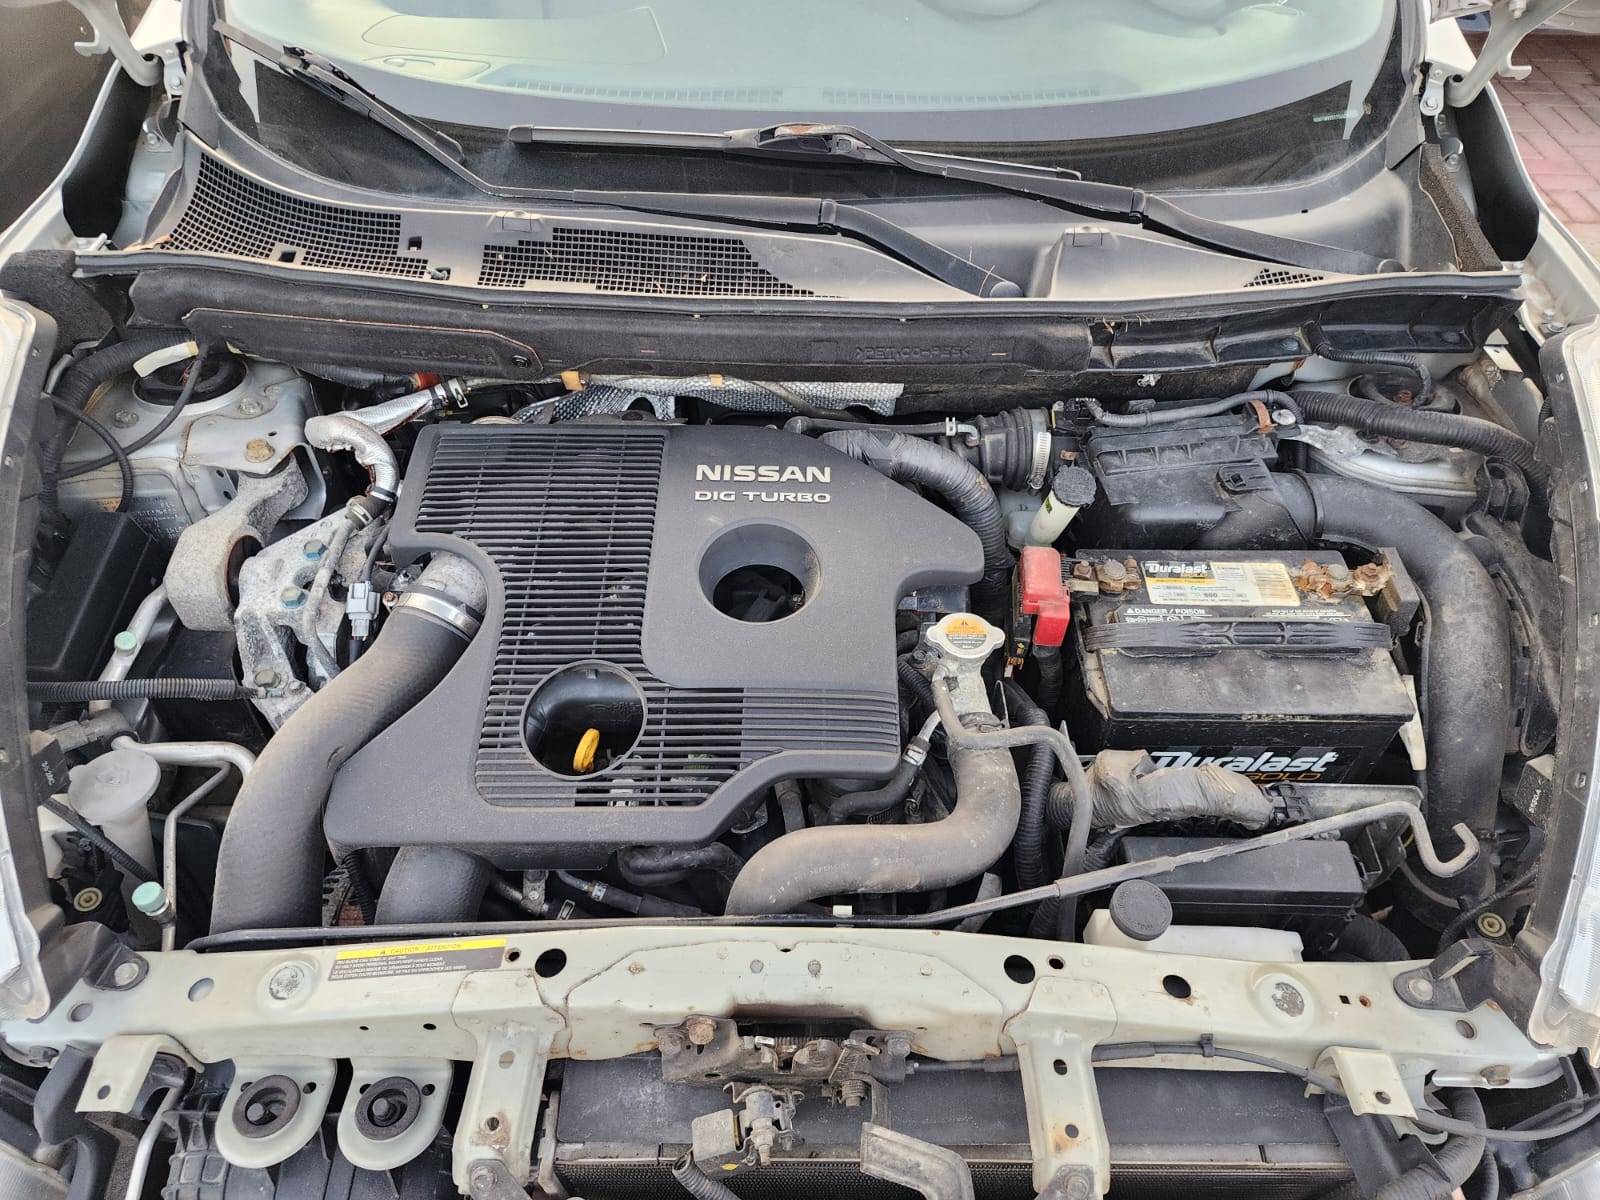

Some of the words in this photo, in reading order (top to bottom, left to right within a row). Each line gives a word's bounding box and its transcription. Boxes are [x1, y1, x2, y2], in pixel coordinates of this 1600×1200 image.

[695, 464, 831, 483] NISSAN
[695, 490, 736, 501] DIG
[742, 491, 831, 503] TURBO
[1145, 562, 1207, 573] Duralast
[1134, 607, 1168, 615] DANGER
[1151, 751, 1339, 773] Duralast
[1246, 772, 1323, 781] GOLD
[390, 946, 419, 955] CAUTION
[425, 943, 462, 951] ATTENTION
